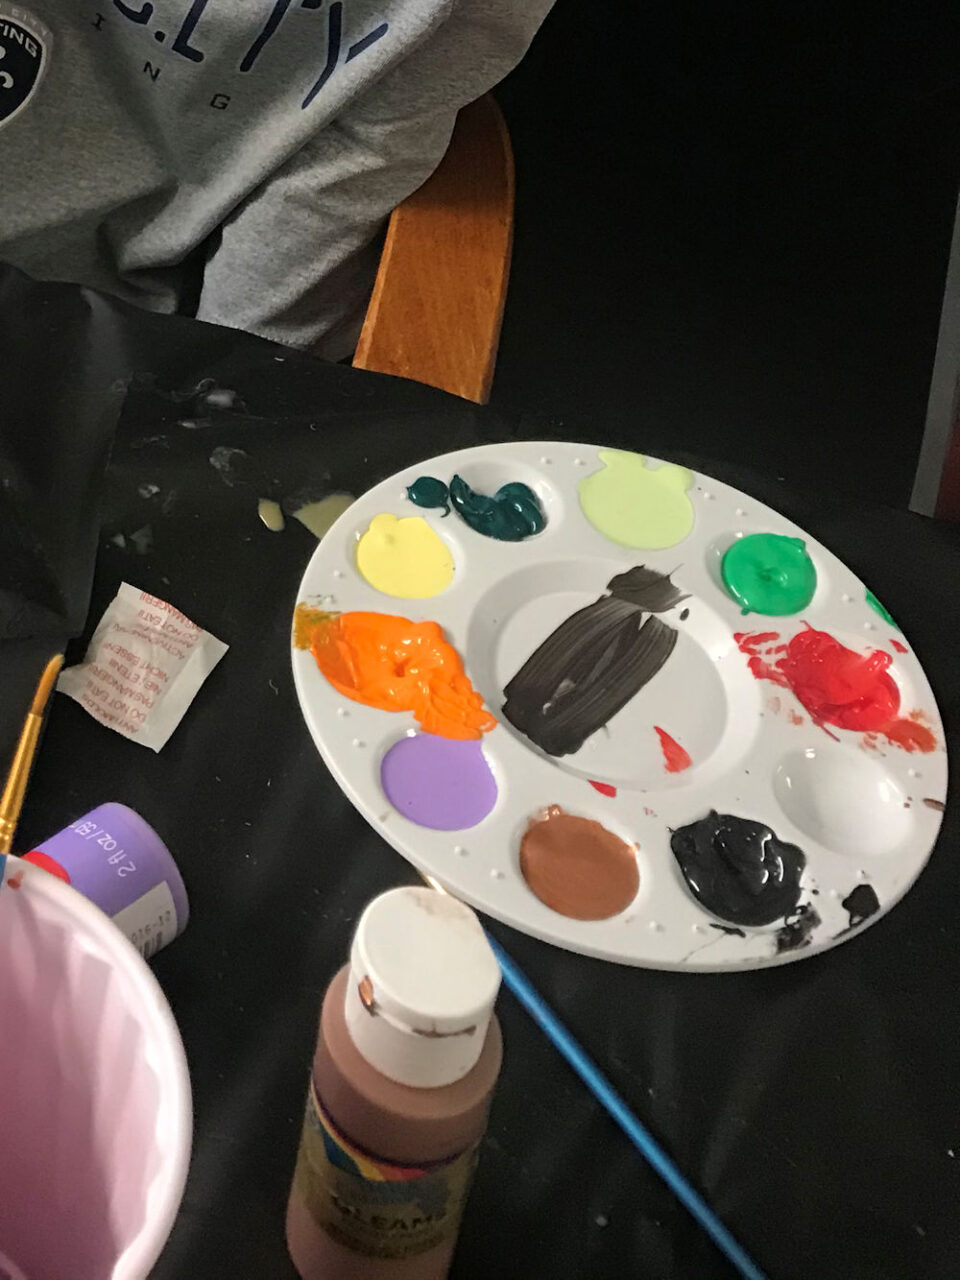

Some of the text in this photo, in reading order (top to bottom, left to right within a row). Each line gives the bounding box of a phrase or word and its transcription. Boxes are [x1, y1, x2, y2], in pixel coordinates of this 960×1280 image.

[97, 832, 118, 852] oz
[107, 848, 126, 866] fl
[116, 860, 137, 878] 2
